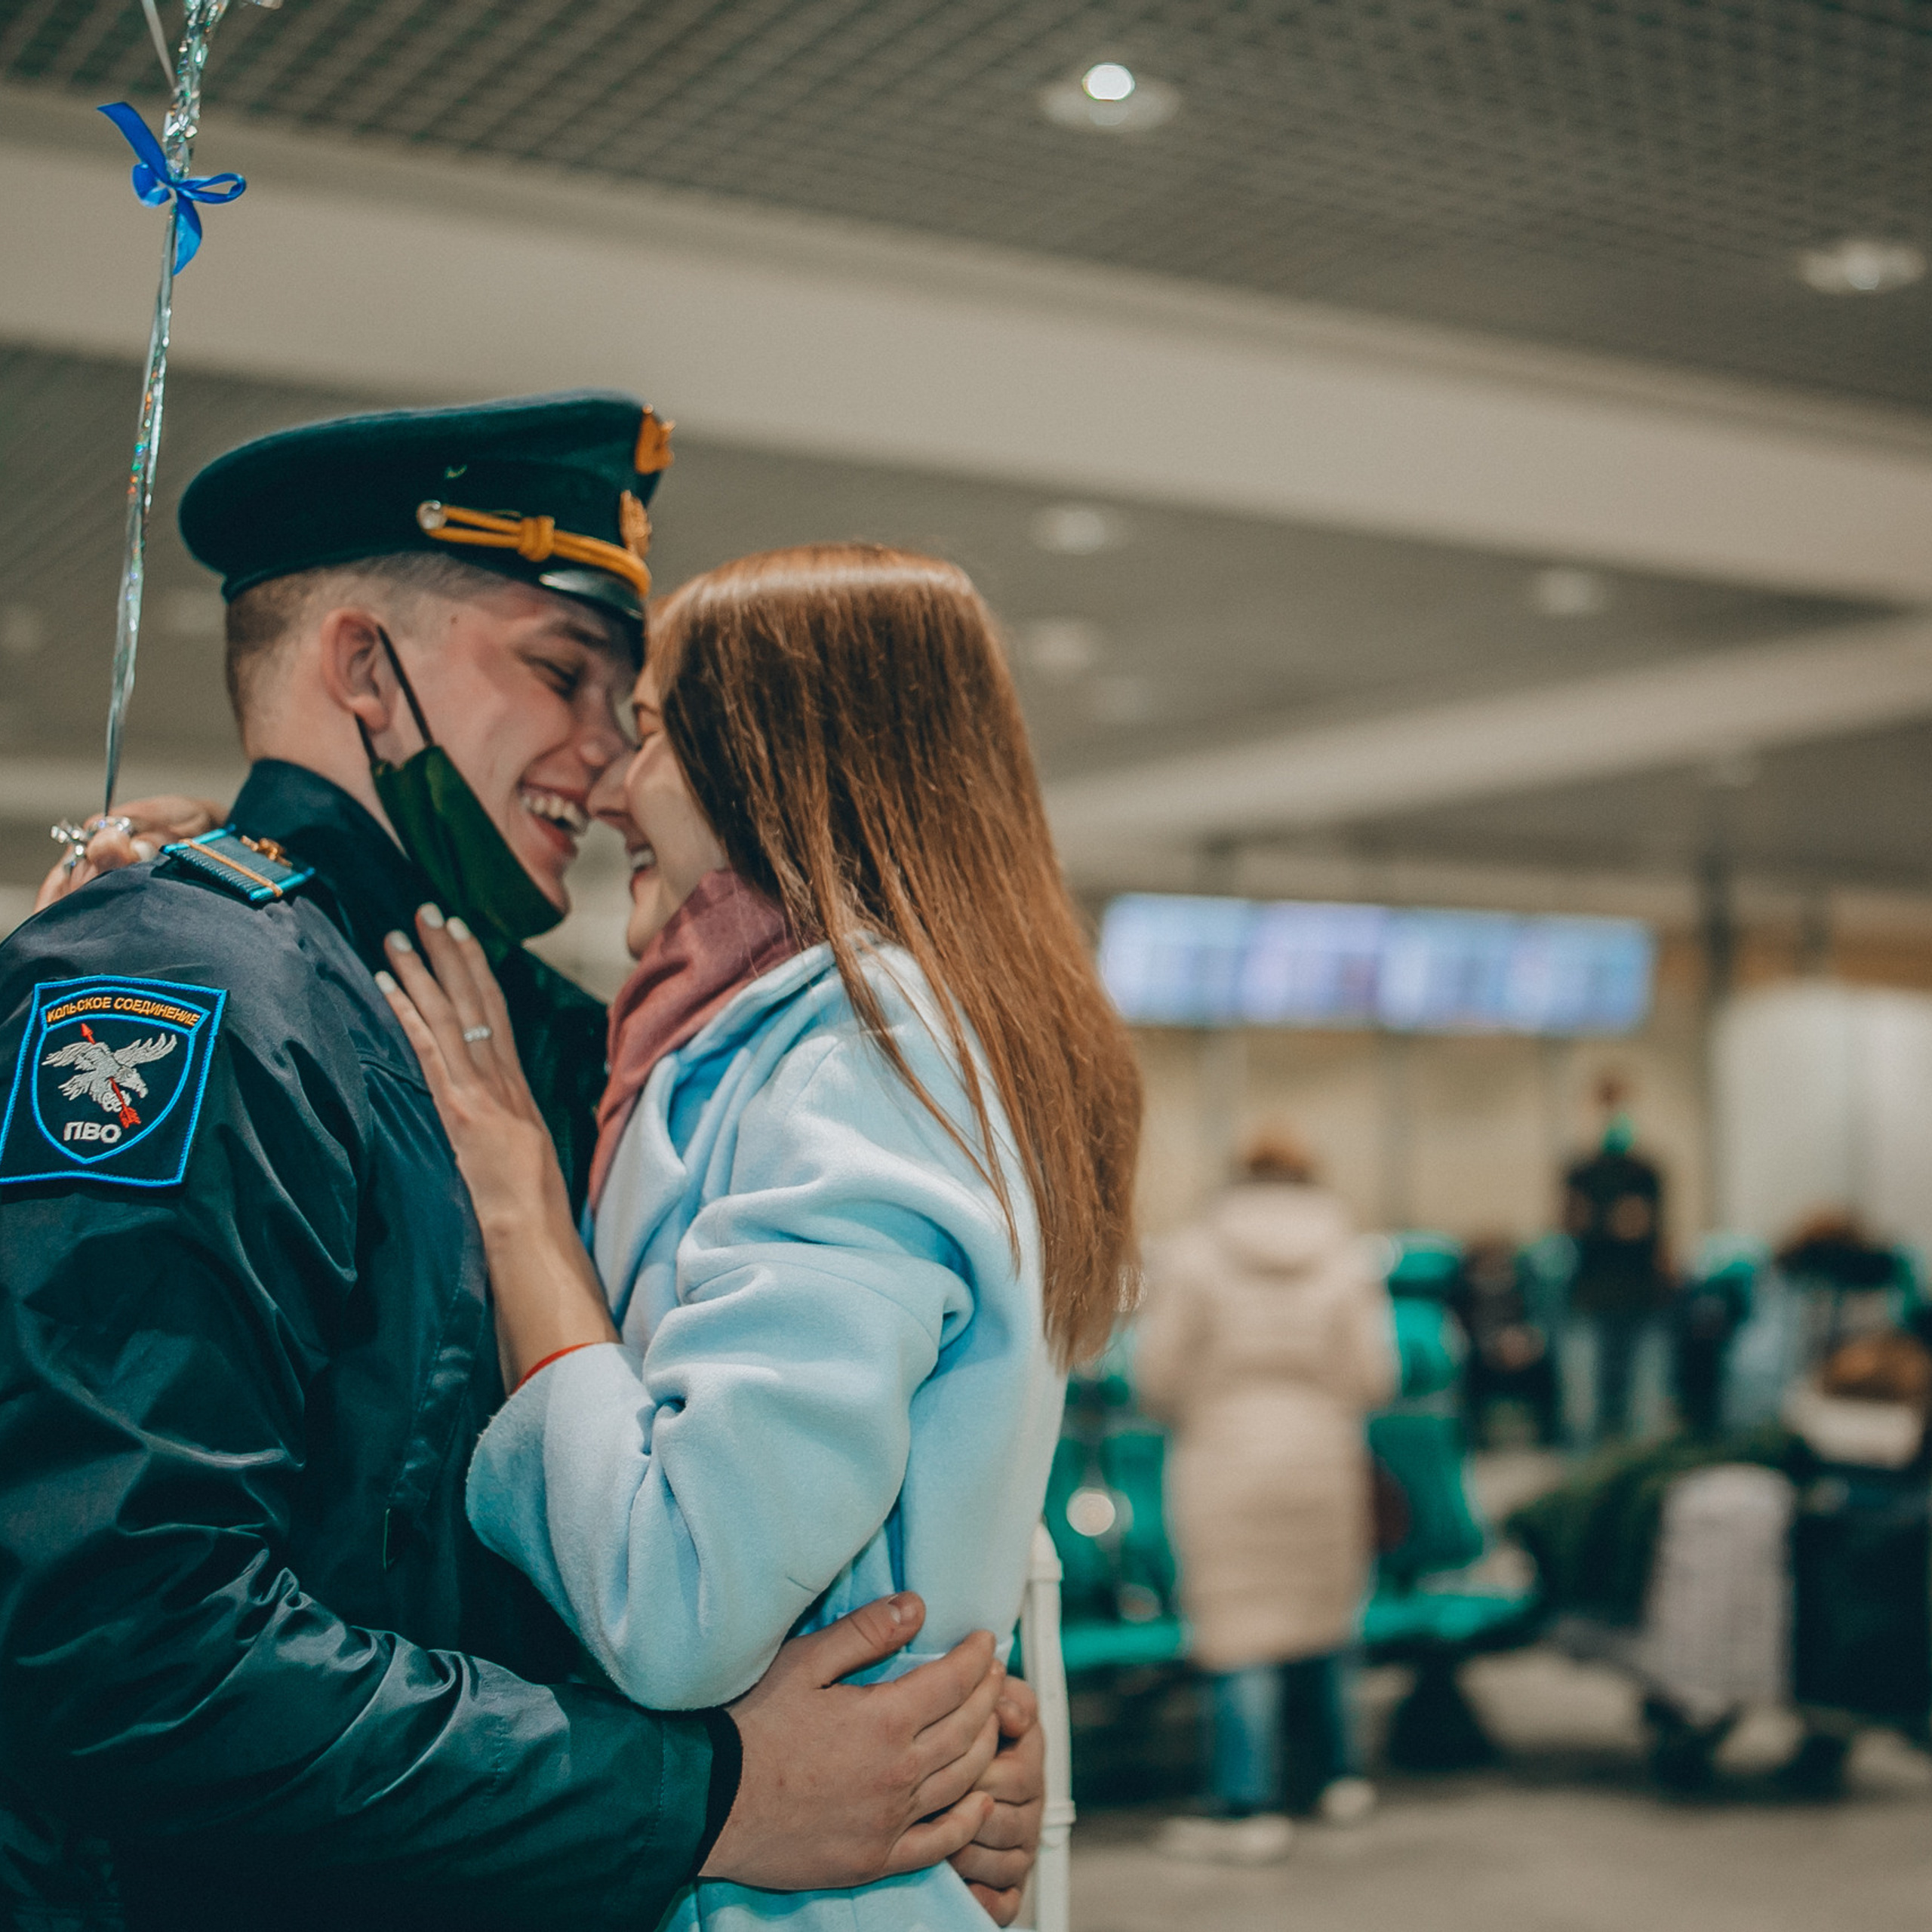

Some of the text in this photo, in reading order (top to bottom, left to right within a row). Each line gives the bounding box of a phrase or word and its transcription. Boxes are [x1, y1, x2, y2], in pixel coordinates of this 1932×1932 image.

[47, 997, 200, 1026] КОЛЬСКОЕ СОЕДИНЕНИЕ
[63, 1121, 121, 1143] ПВО
